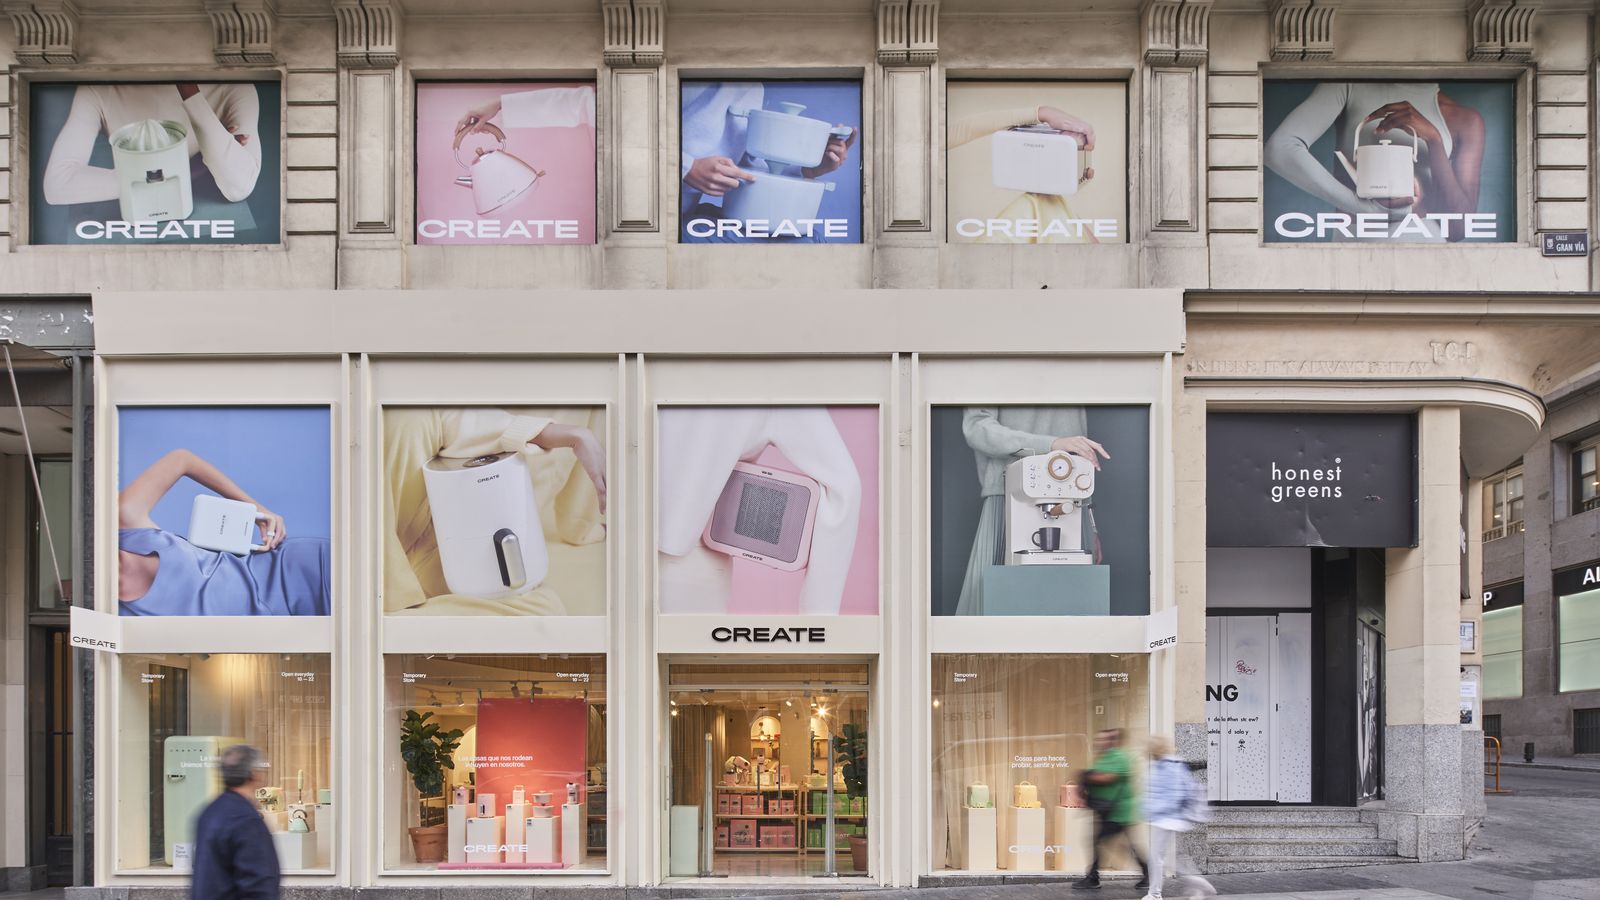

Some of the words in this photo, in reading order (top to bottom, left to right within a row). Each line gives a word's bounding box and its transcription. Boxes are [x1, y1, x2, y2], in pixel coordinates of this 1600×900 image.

[75, 219, 235, 240] CREATE
[418, 219, 579, 239] CREATE
[686, 218, 849, 239] CREATE
[955, 218, 1118, 238] CREATE
[1274, 212, 1498, 239] CREATE
[1556, 243, 1574, 252] GRAN
[1574, 241, 1585, 252] VÍA
[476, 474, 500, 484] CREATE
[1271, 485, 1342, 503] greens
[741, 552, 763, 562] CREATE
[711, 626, 825, 643] CREATE
[1149, 635, 1177, 649] CREATE
[72, 635, 117, 650] CREATE
[141, 672, 165, 680] Temporary
[512, 754, 533, 762] rodean
[463, 843, 529, 854] CREATE
